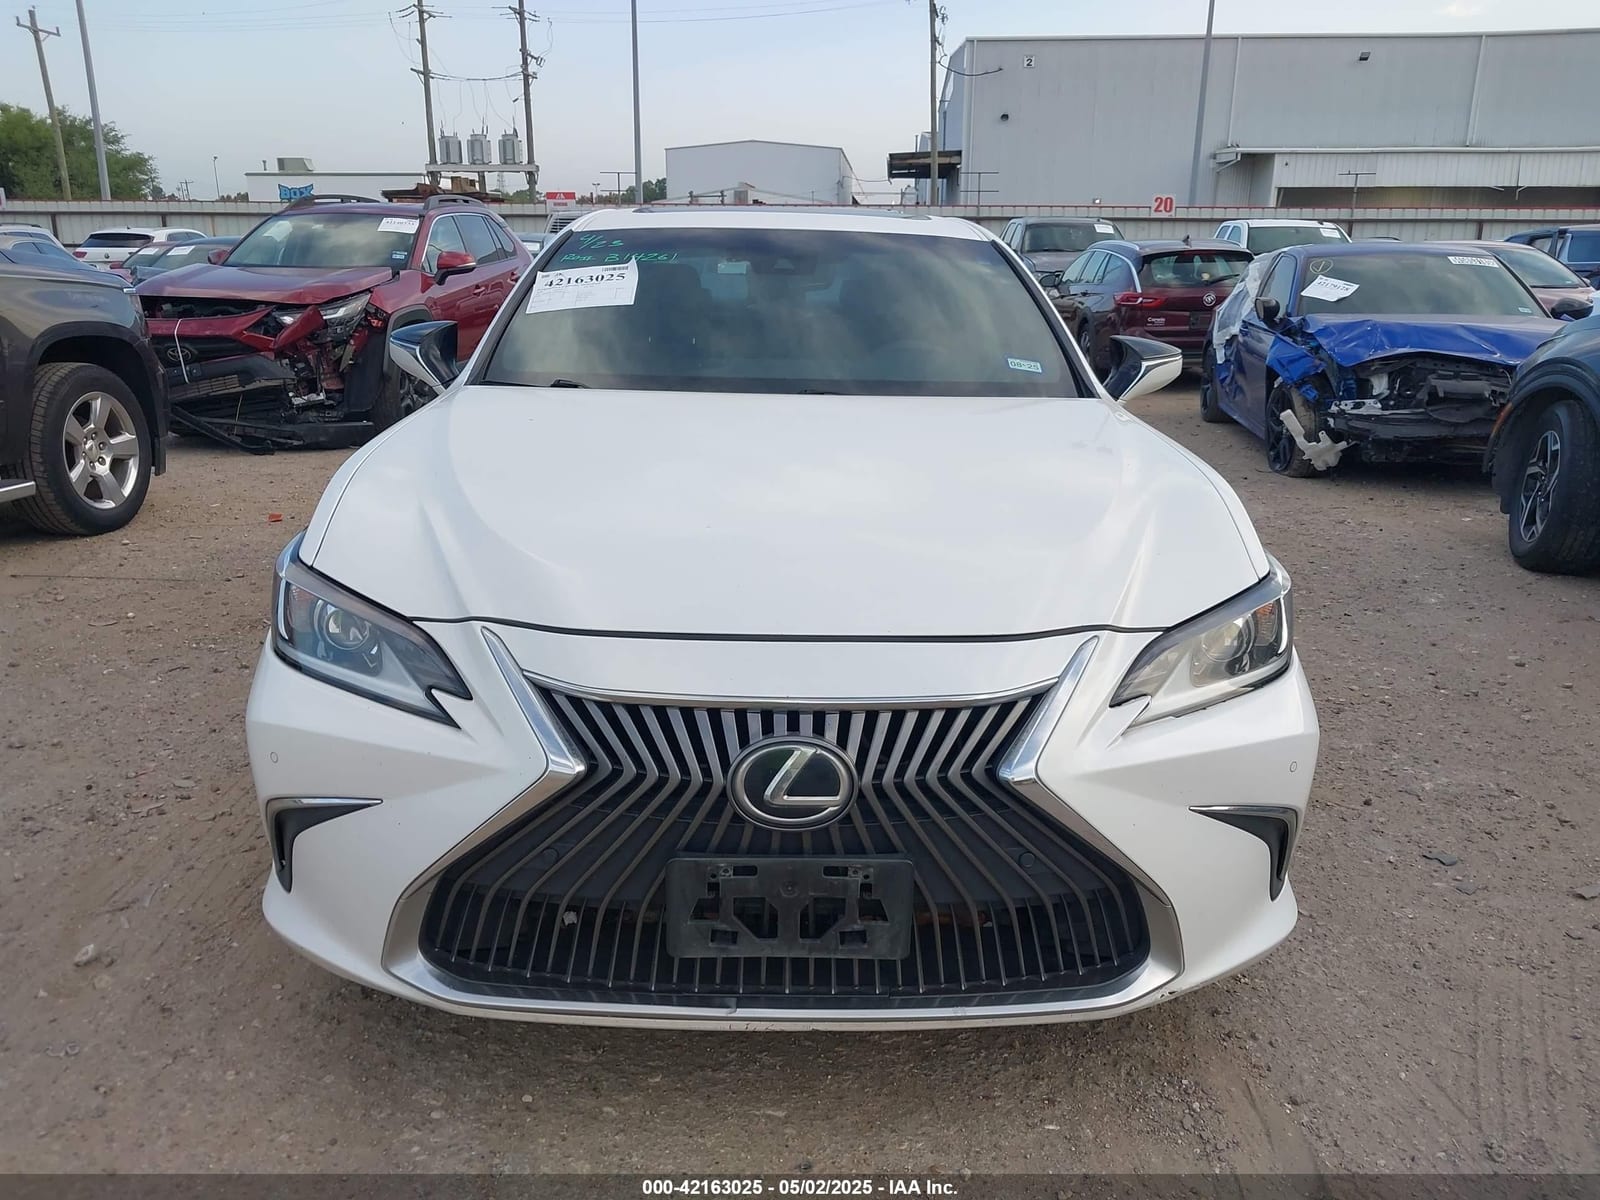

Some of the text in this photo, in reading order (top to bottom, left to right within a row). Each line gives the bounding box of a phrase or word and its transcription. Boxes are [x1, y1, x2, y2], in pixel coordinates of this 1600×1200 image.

[1026, 58, 1033, 67] 2
[278, 184, 314, 201] BOX
[1153, 196, 1174, 213] 20
[544, 272, 626, 287] 42163025
